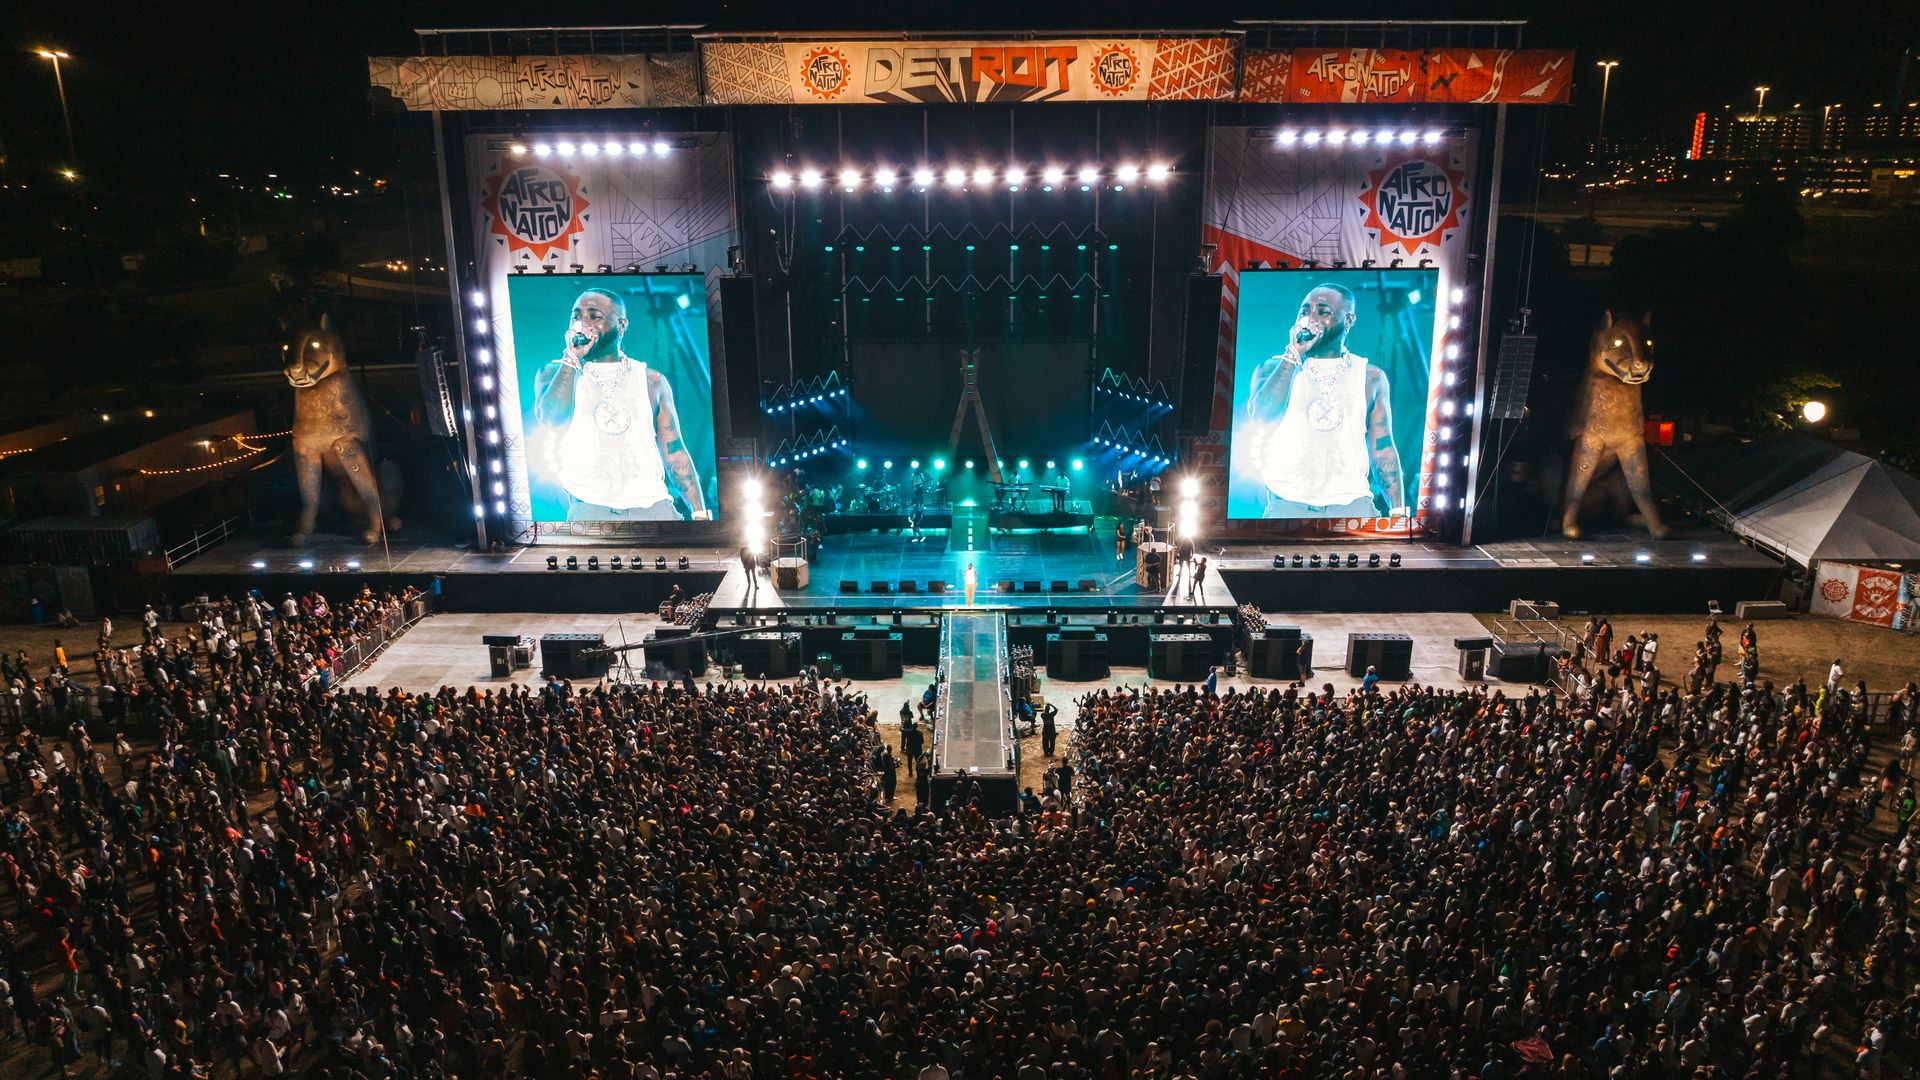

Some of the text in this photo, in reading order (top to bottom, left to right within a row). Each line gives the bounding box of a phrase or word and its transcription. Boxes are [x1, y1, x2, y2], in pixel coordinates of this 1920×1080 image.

[809, 70, 842, 90] NATION
[811, 56, 841, 73] AFRO
[864, 46, 1077, 98] DETROIT
[1099, 66, 1131, 87] NATION
[1101, 53, 1130, 71] AFRO
[1307, 53, 1411, 97] AFRO NATION
[518, 60, 620, 104] AFRO NATION
[502, 168, 566, 205] AFRO
[1383, 162, 1448, 200] AFRO
[501, 197, 570, 241] NATION
[1379, 191, 1449, 236] NATION
